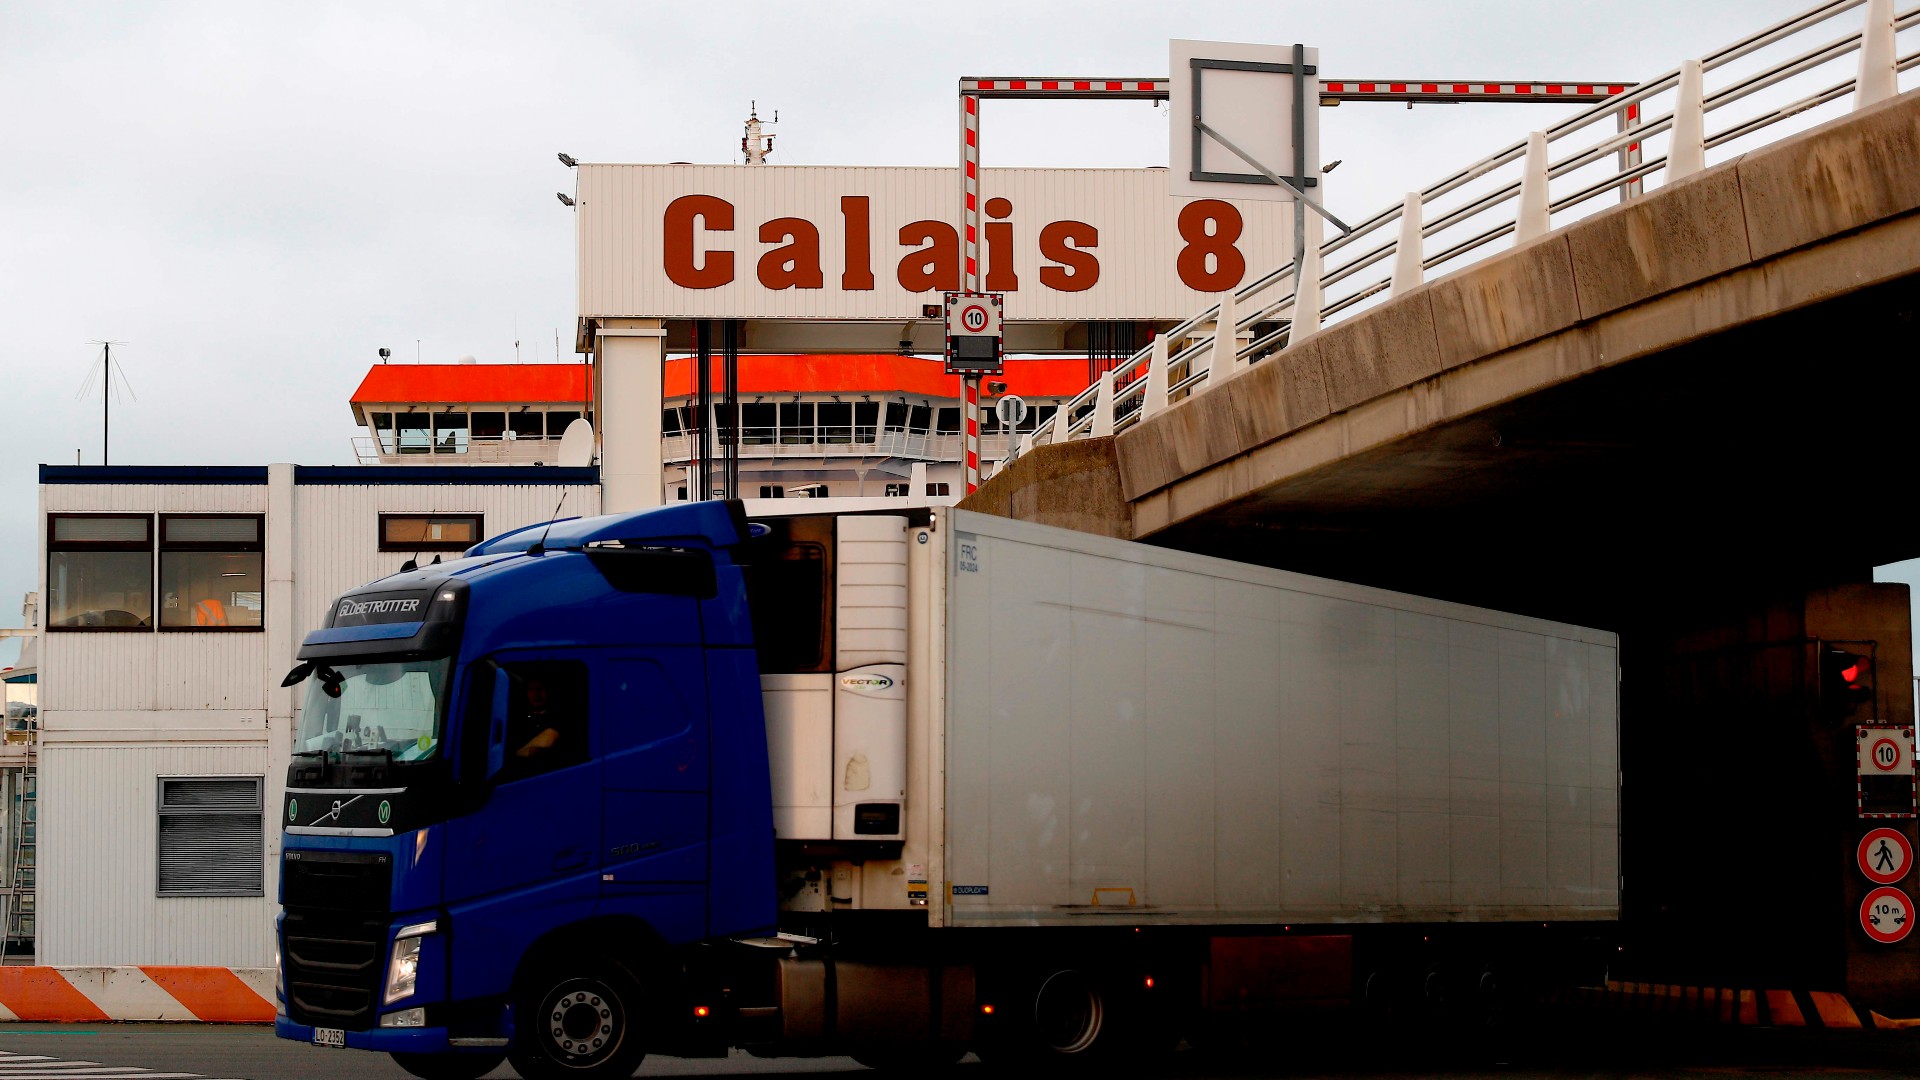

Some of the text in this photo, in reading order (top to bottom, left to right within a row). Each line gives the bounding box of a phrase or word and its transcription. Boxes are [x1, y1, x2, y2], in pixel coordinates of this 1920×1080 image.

[663, 194, 1246, 293] Calais 8
[967, 312, 982, 325] 10
[961, 544, 977, 561] FRC
[339, 599, 420, 616] GLOBETROTTER
[1878, 746, 1894, 763] 10
[285, 852, 300, 860] VOLVO
[1875, 904, 1890, 915] 10
